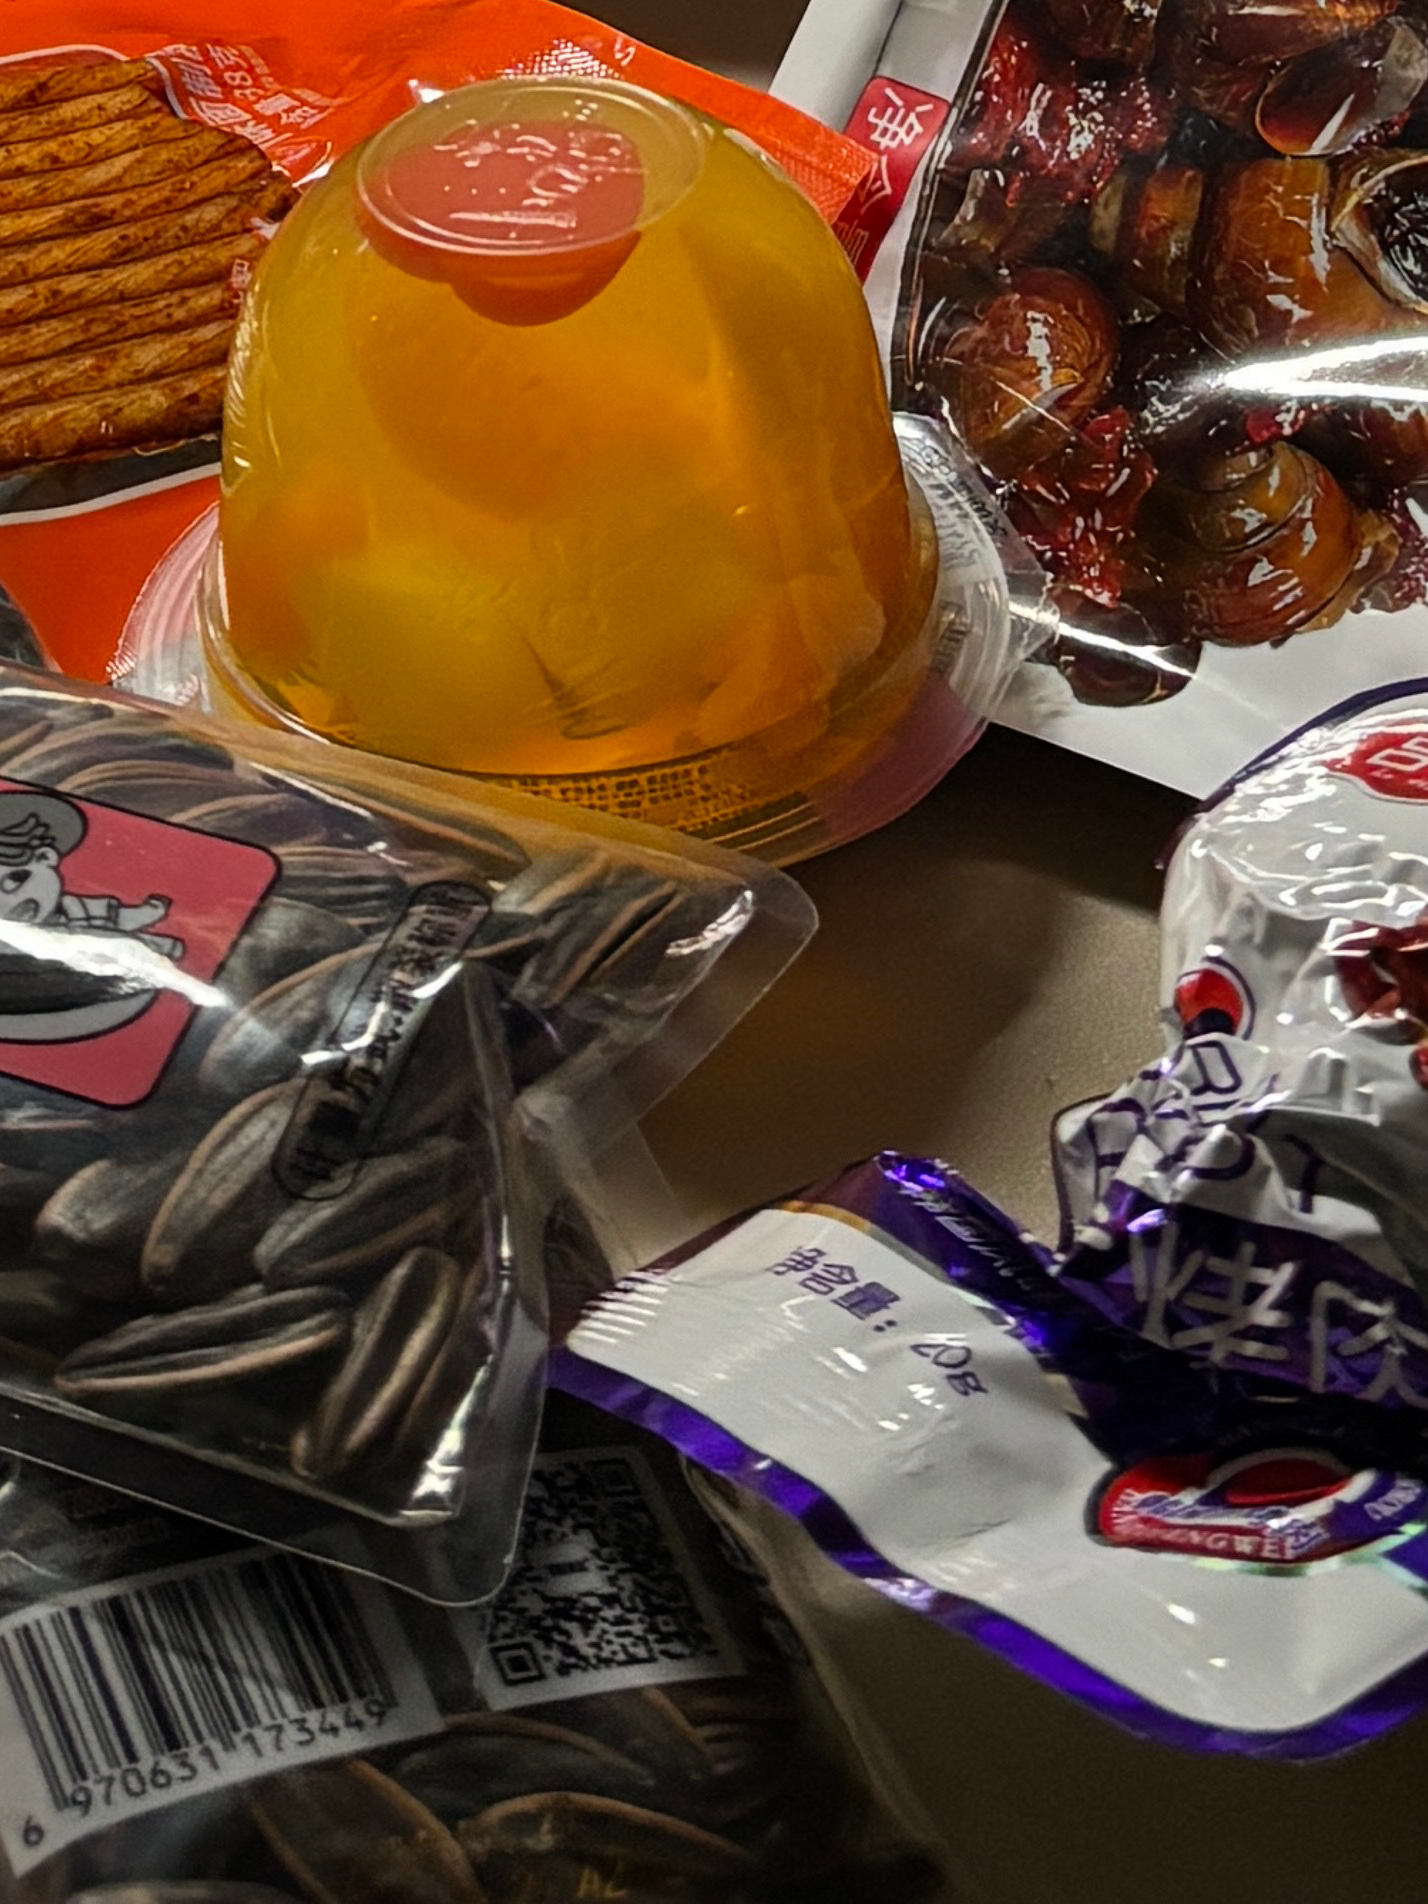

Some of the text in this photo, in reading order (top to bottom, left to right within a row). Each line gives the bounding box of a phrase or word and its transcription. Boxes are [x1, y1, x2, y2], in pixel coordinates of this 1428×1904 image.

[21, 1694, 393, 1848] 6 970631 173449
